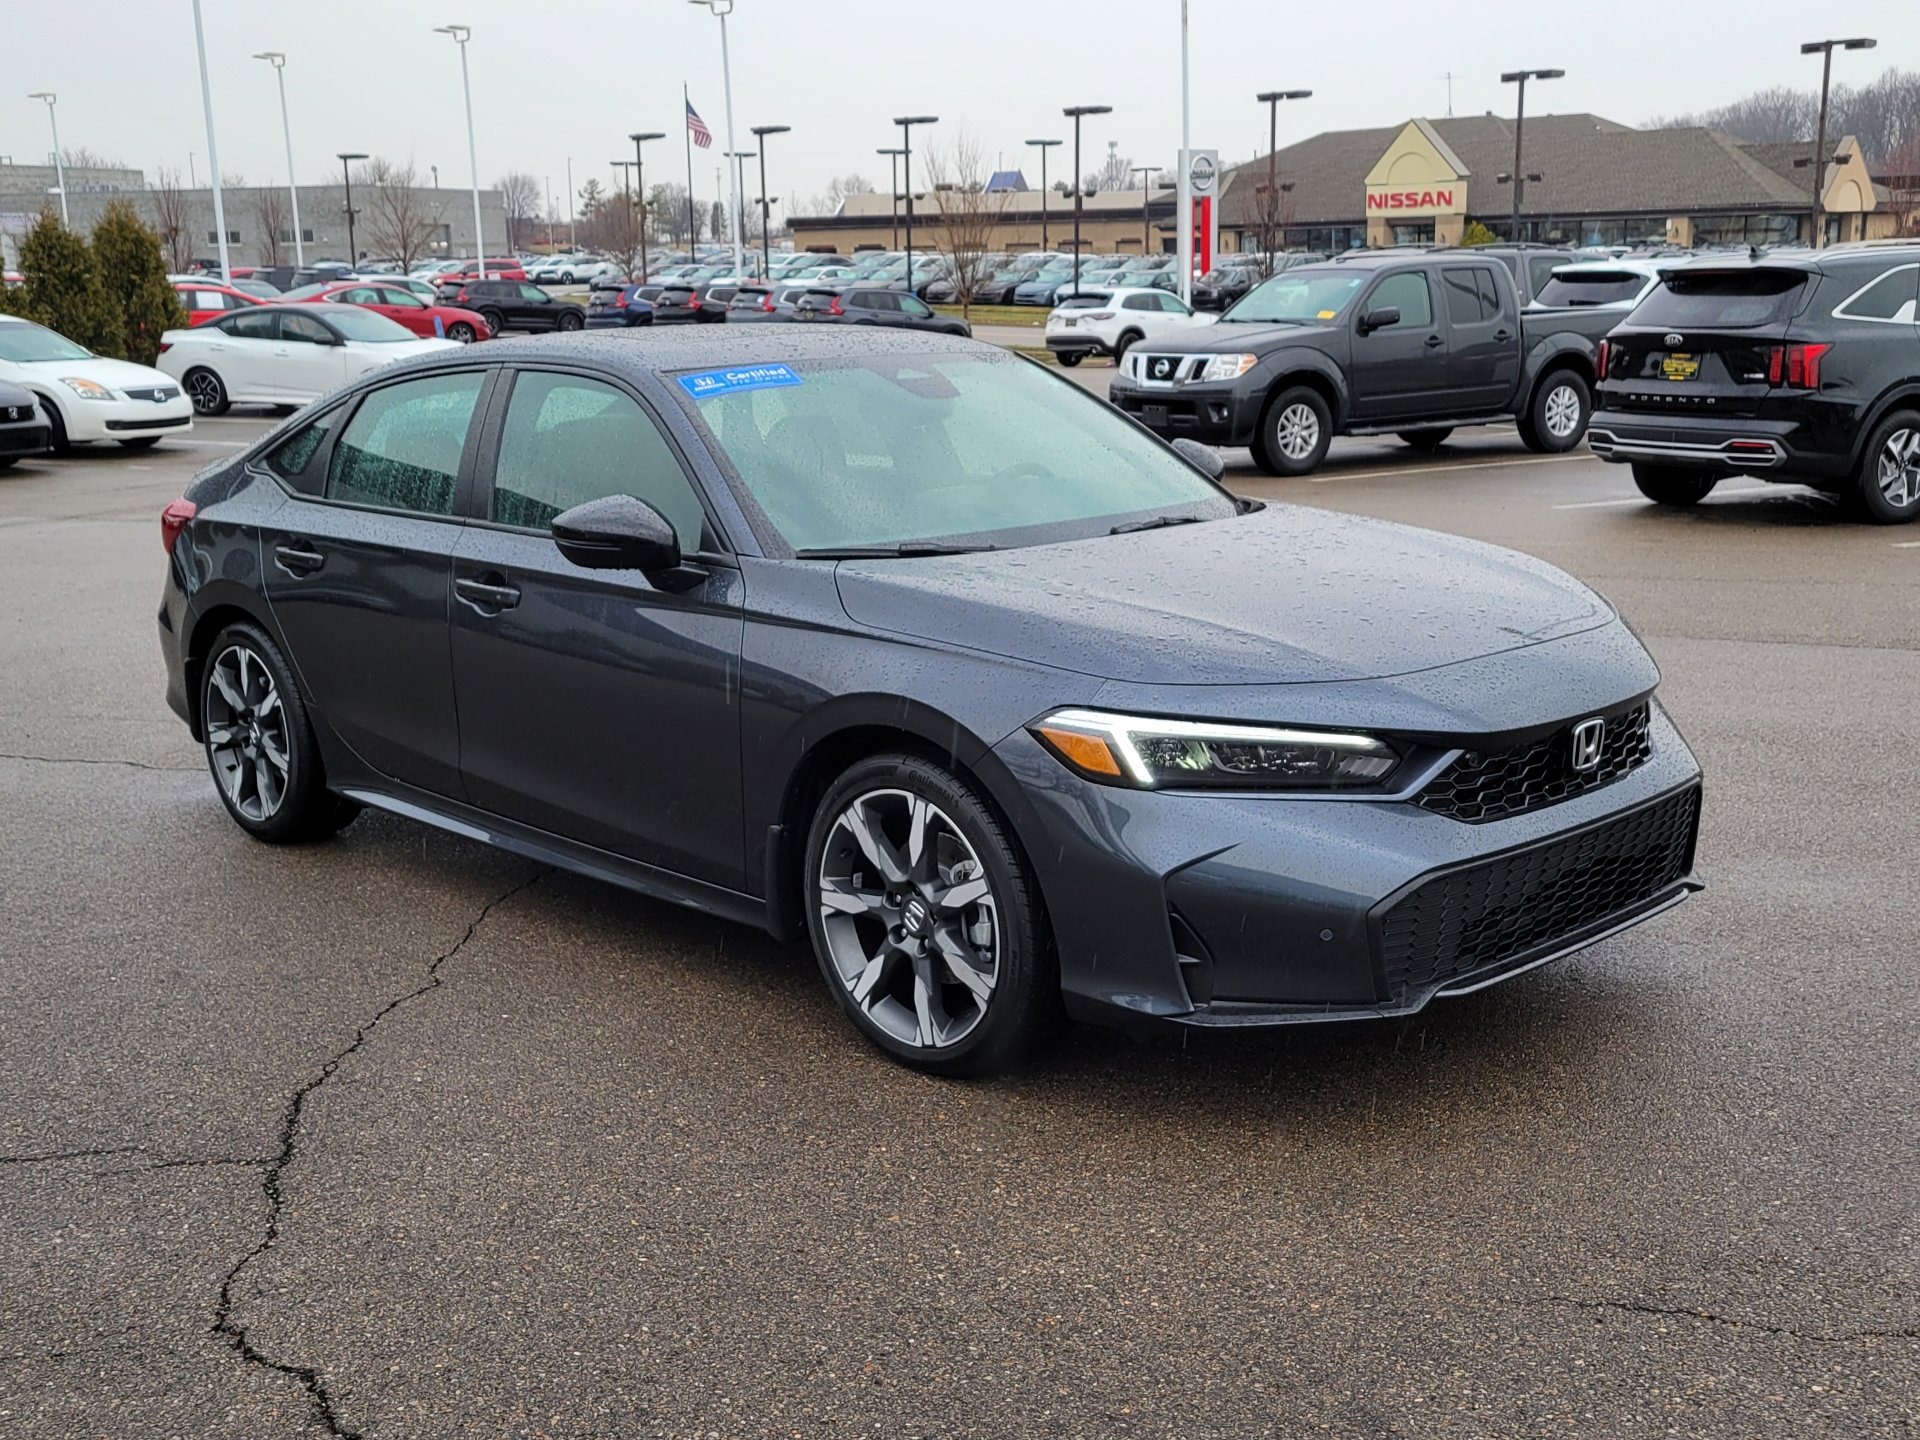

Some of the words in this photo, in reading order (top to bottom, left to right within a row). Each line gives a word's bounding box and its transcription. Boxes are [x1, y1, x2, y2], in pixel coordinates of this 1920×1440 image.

[1367, 190, 1452, 209] NISSAN
[1665, 335, 1682, 346] KIA
[726, 367, 787, 380] Certified
